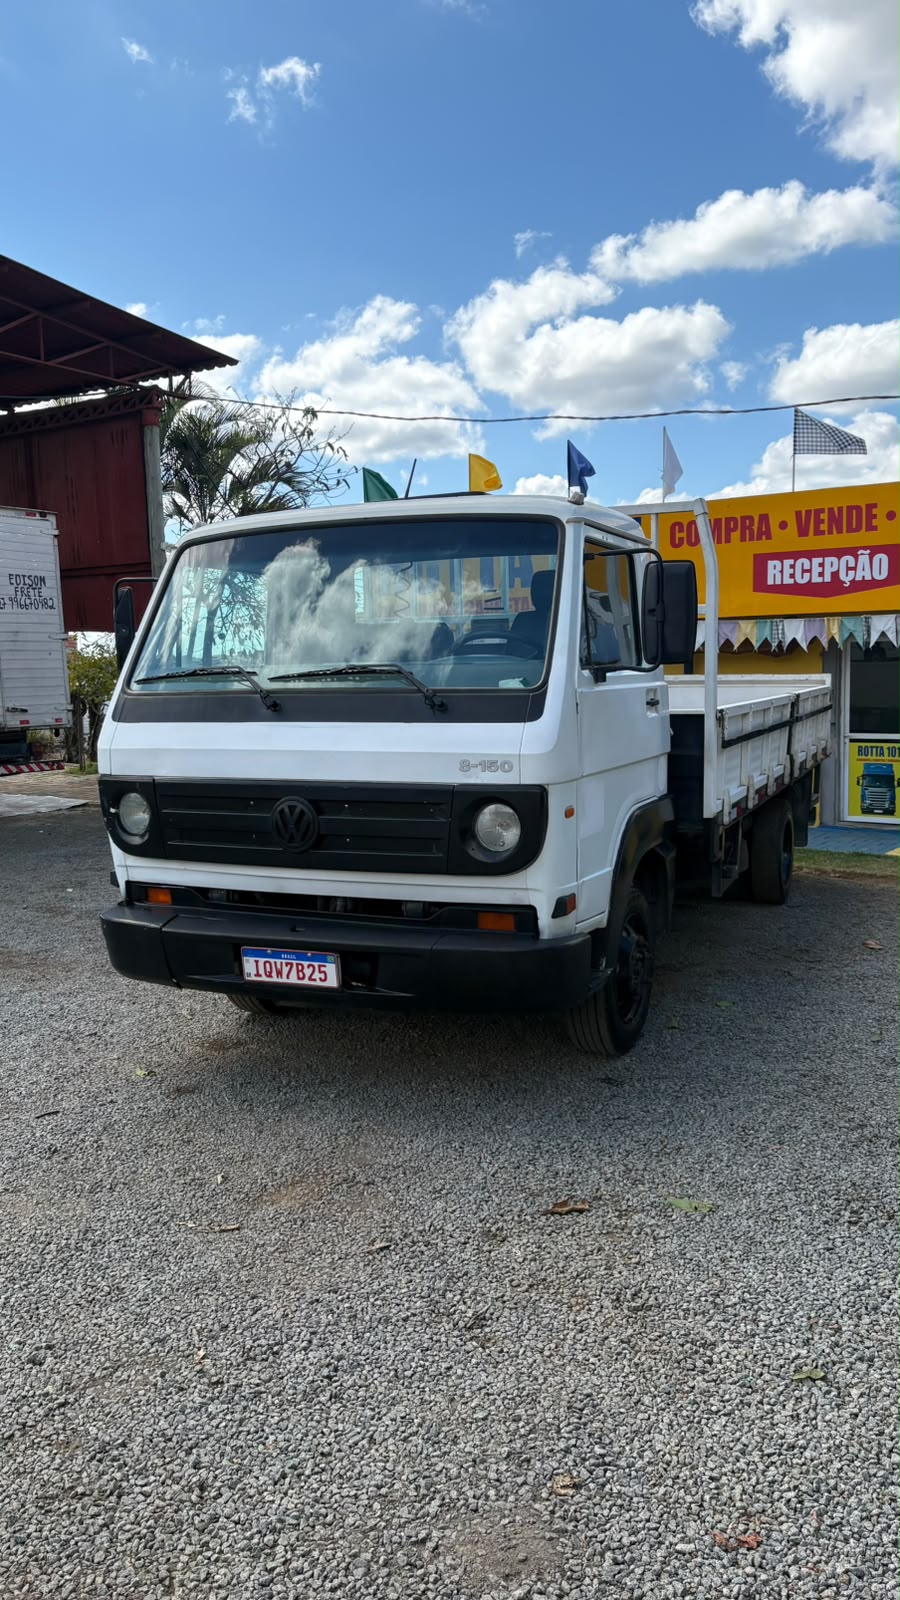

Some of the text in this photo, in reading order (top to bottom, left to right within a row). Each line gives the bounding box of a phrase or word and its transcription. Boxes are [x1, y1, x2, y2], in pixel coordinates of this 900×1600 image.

[669, 502, 879, 549] COMPRA VENDE
[767, 549, 889, 587] RECEPÇÃO
[8, 573, 46, 587] EDISON
[14, 586, 43, 598] FRETE
[857, 745, 885, 758] ROTTA
[458, 759, 514, 773] 8-150
[253, 959, 328, 983] IQW7B25
